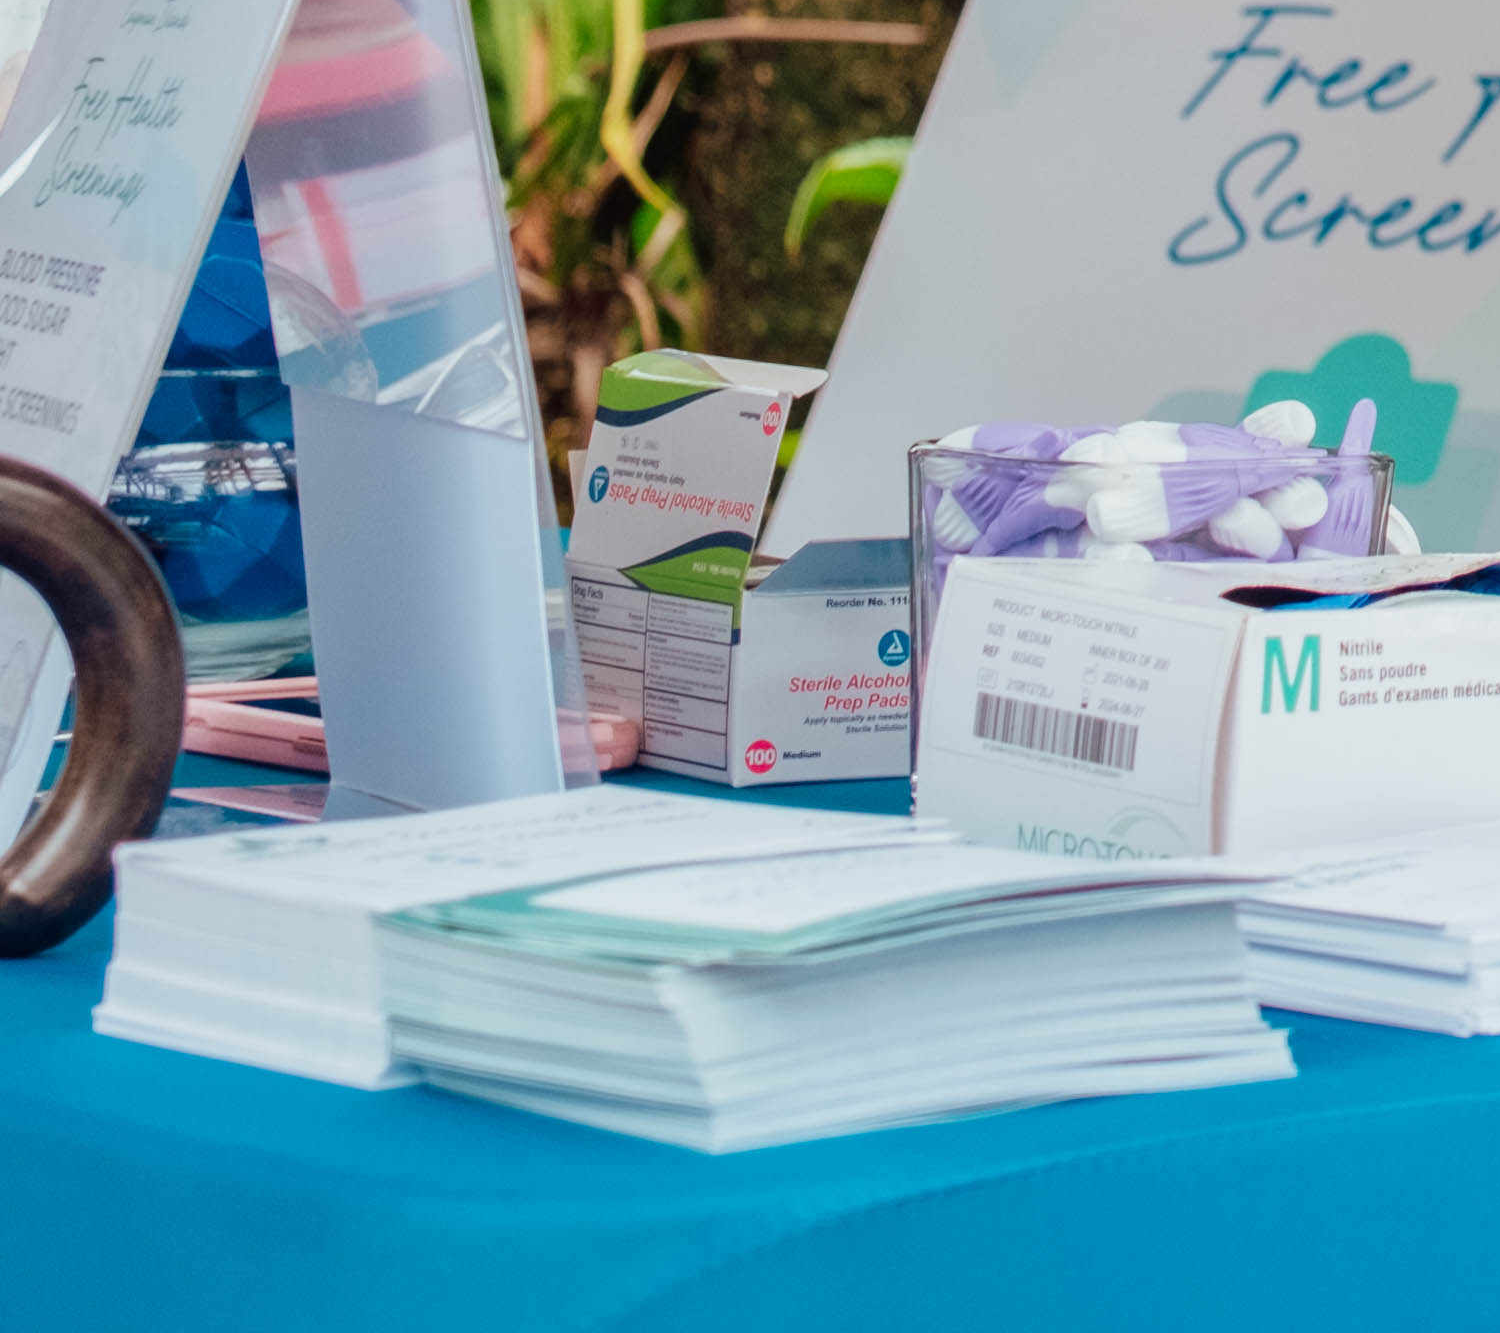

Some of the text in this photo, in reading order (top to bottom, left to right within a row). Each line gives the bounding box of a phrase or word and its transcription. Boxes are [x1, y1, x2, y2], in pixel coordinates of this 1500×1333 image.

[1181, 5, 1437, 120] Free
[55, 56, 185, 153] Free Health
[34, 125, 147, 227] Screenings
[40, 256, 107, 298] PRESSURE
[764, 410, 781, 428] 100
[608, 481, 756, 523] Sterile Alcohol Prep Pads
[826, 598, 864, 609] Reorder
[867, 596, 887, 608] No.
[1339, 640, 1384, 657] Nitrile
[789, 672, 911, 693] Sterile Alcohol
[1261, 634, 1321, 714] M
[1339, 661, 1428, 683] Sans poudre
[824, 692, 909, 713] Prep Pads
[1338, 689, 1379, 707] Gants
[1383, 685, 1449, 705] d'examen
[803, 716, 829, 726] Apply
[830, 713, 865, 724] topically
[878, 711, 909, 721] needed
[845, 722, 908, 734] Sterile Solution
[745, 748, 822, 766] 100 Medium
